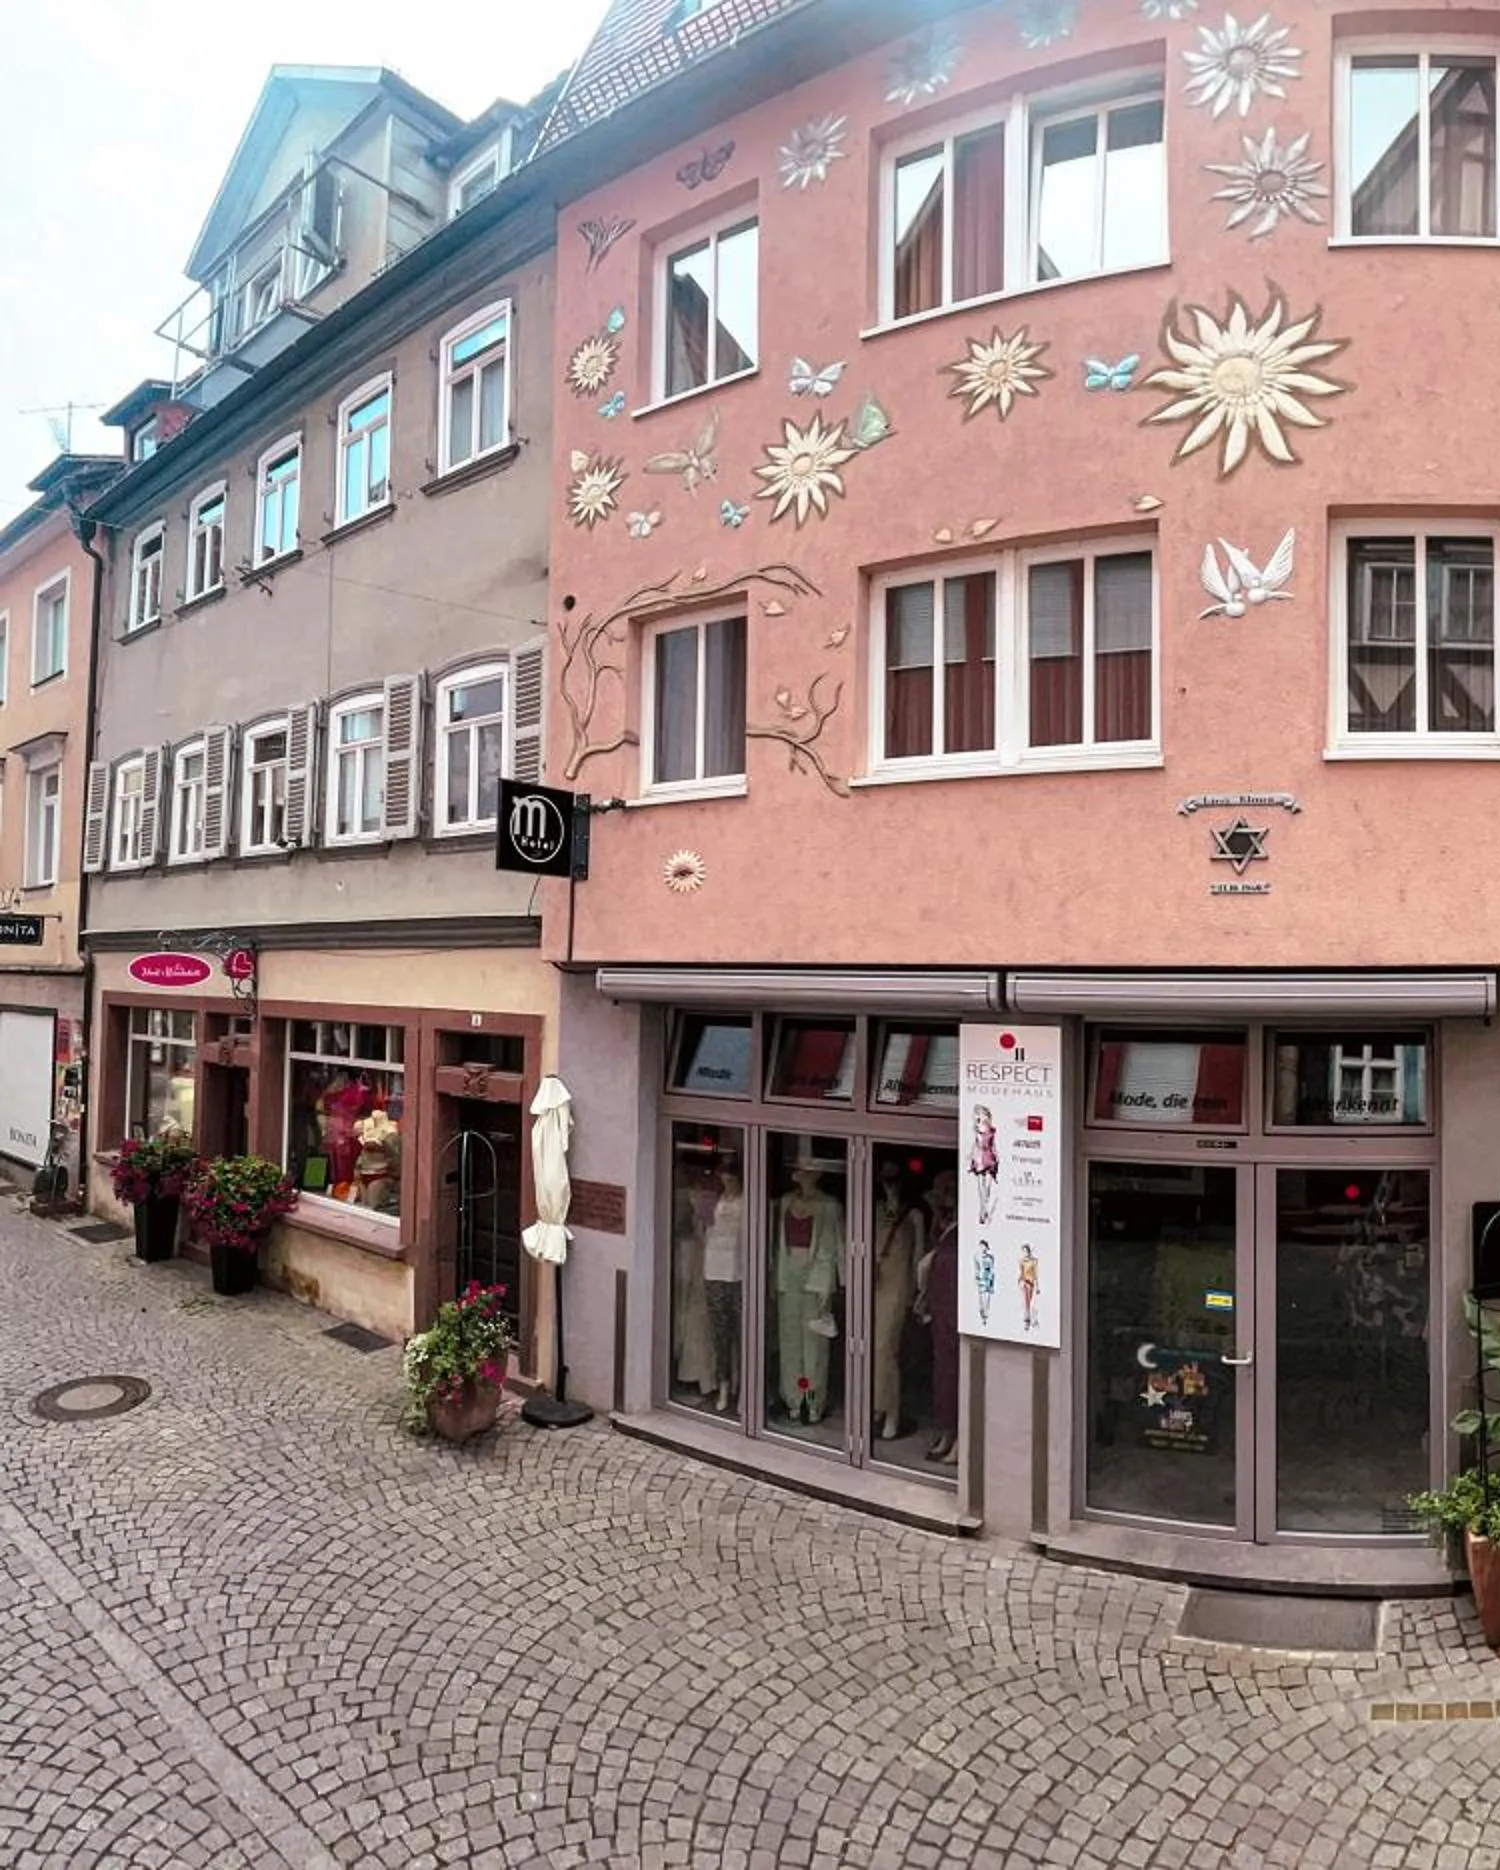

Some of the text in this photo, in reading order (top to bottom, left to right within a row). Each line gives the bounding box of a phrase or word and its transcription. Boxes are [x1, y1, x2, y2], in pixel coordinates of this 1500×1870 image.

[521, 835, 554, 850] Hotel
[966, 1063, 1053, 1083] RESPECT
[967, 1085, 1053, 1099] MODEHAUS
[1163, 1092, 1188, 1109] die
